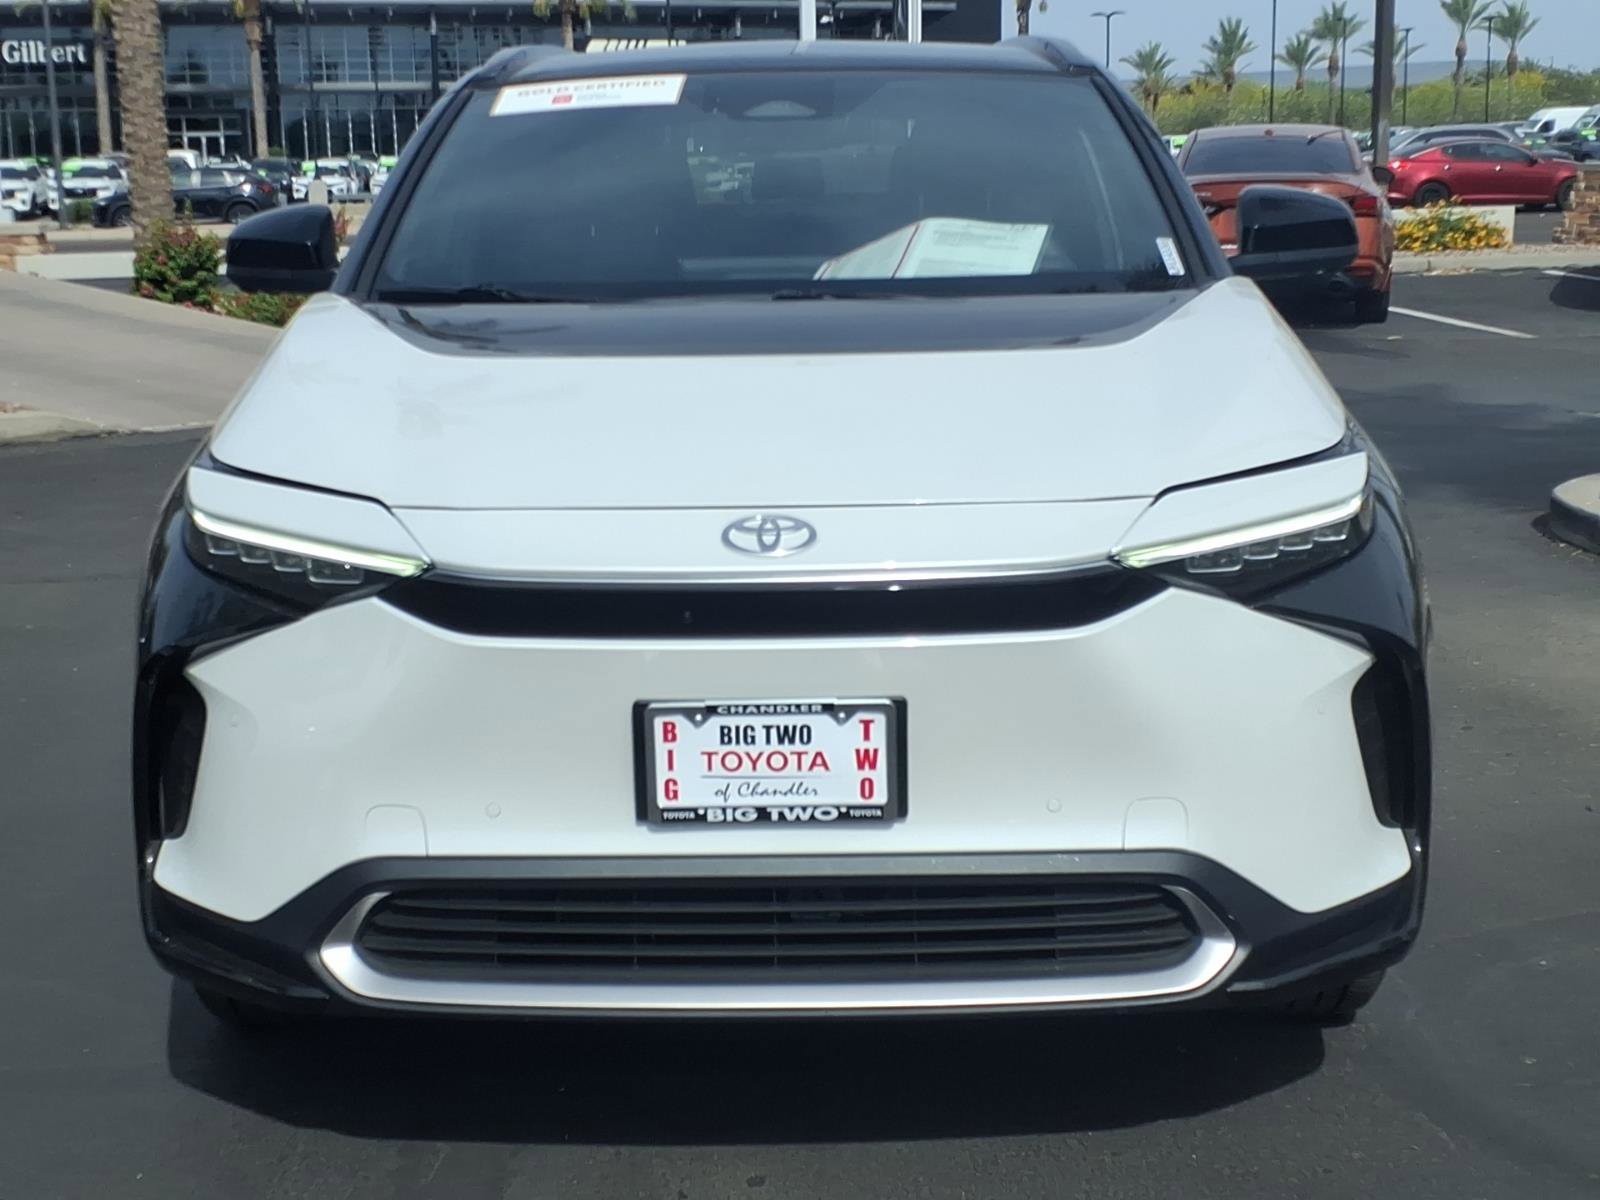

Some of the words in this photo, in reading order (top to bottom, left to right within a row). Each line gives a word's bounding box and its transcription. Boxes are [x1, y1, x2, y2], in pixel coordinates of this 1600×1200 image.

[716, 704, 823, 715] CHANDLER
[719, 724, 756, 746] BIG
[761, 723, 812, 746] TWO
[700, 750, 830, 773] TOYOTA
[714, 782, 731, 803] of
[737, 781, 818, 798] Chandler
[663, 811, 696, 820] TOYOTA
[849, 808, 882, 818] TOYOTA
